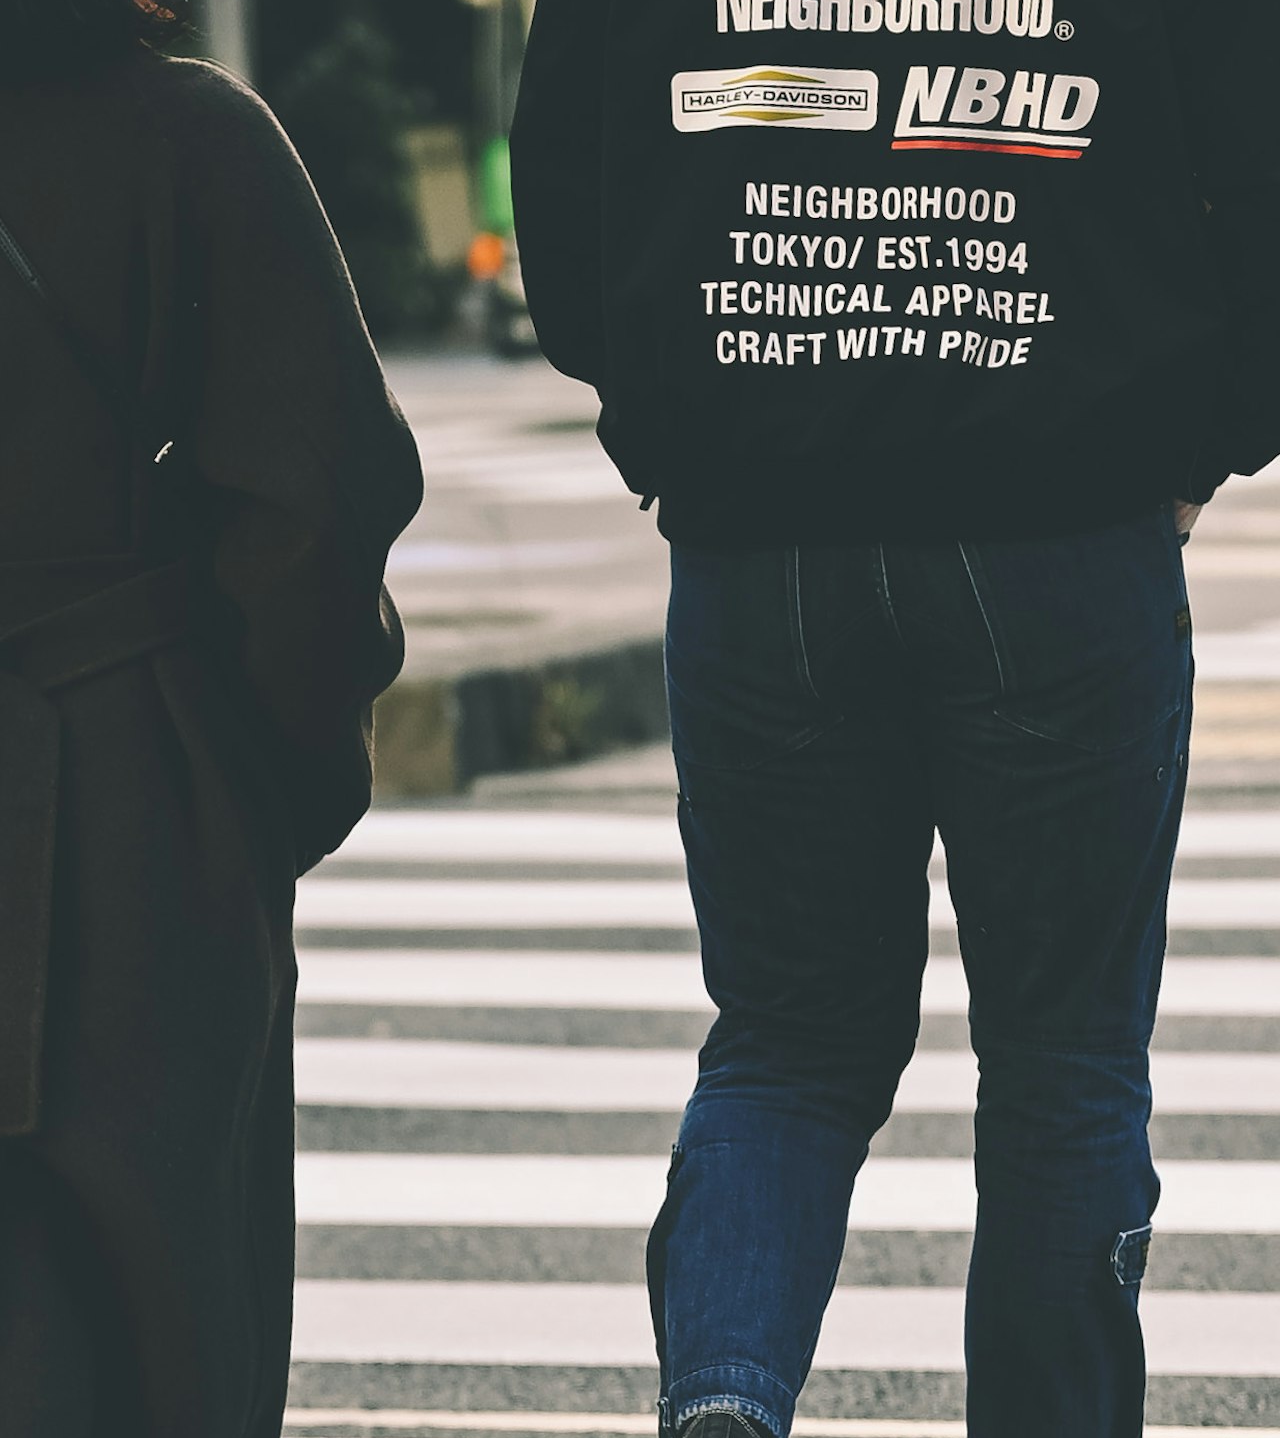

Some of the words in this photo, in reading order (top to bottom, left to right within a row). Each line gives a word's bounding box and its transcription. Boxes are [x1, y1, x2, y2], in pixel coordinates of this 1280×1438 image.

[689, 90, 861, 107] HARLEY-DAVIDSON
[894, 65, 1100, 137] NBHD
[745, 181, 1017, 224] NEIGHBORHOOD
[728, 230, 865, 270] TOKYO/
[876, 236, 1029, 275] EST.1994
[700, 280, 892, 318] TECHNICAL
[904, 284, 1055, 325] APPAREL
[716, 329, 828, 366] CRAFT
[836, 325, 927, 361] WITH
[938, 329, 1033, 369] PRIDE
